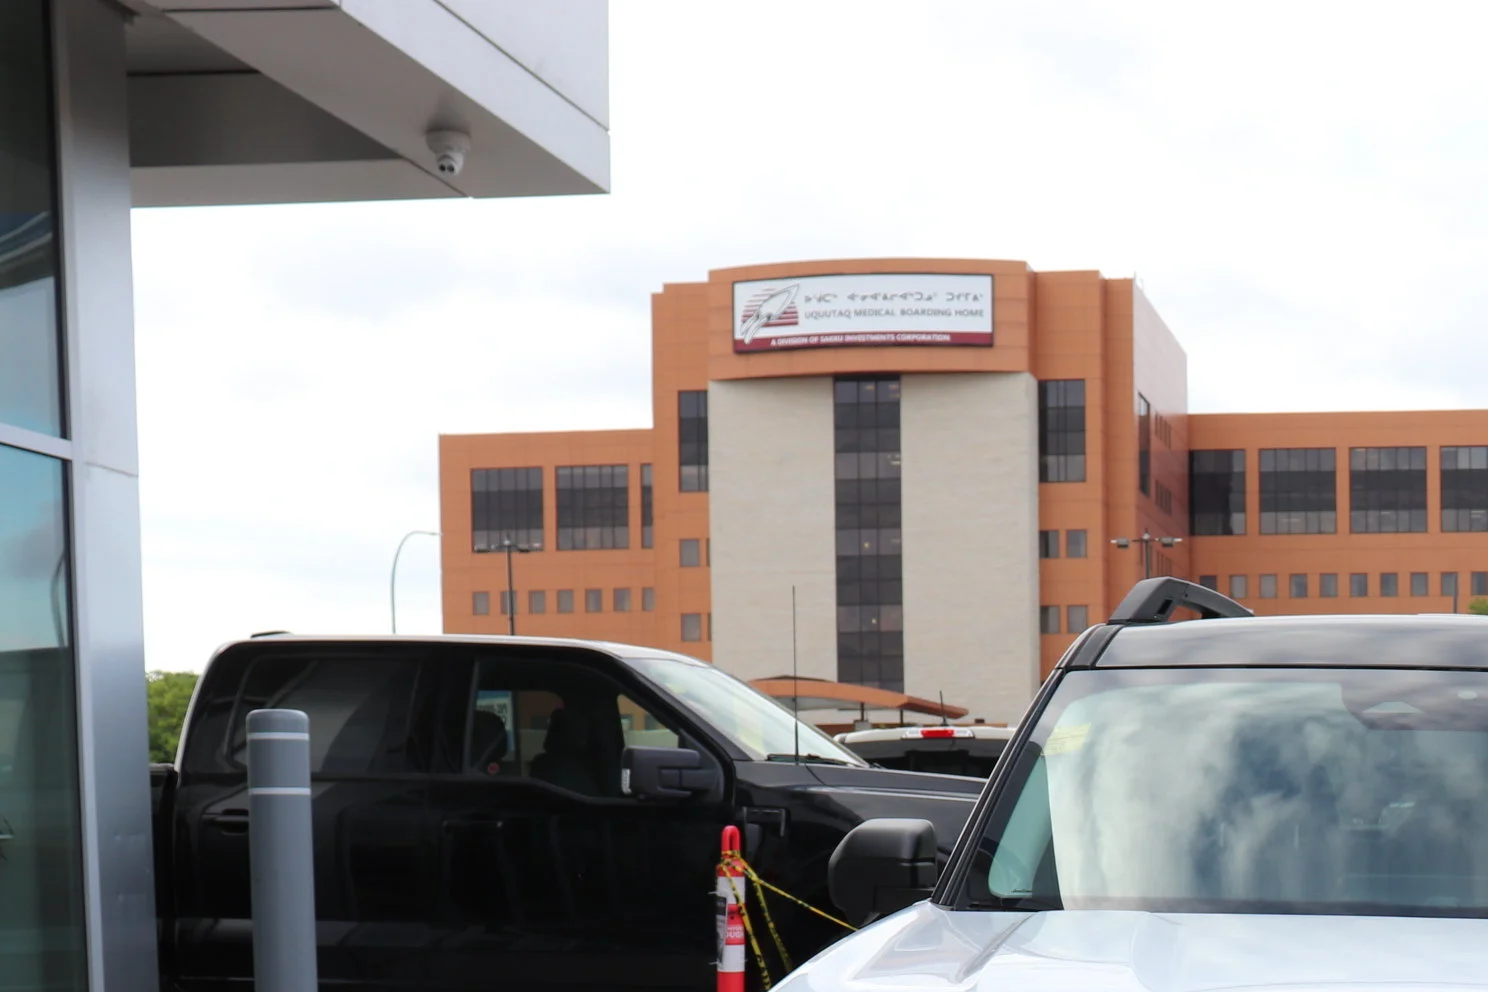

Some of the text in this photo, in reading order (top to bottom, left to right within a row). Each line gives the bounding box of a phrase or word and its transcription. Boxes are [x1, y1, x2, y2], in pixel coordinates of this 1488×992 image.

[804, 308, 984, 320] UQUUTAQ MEDICAL BOARDING HOME
